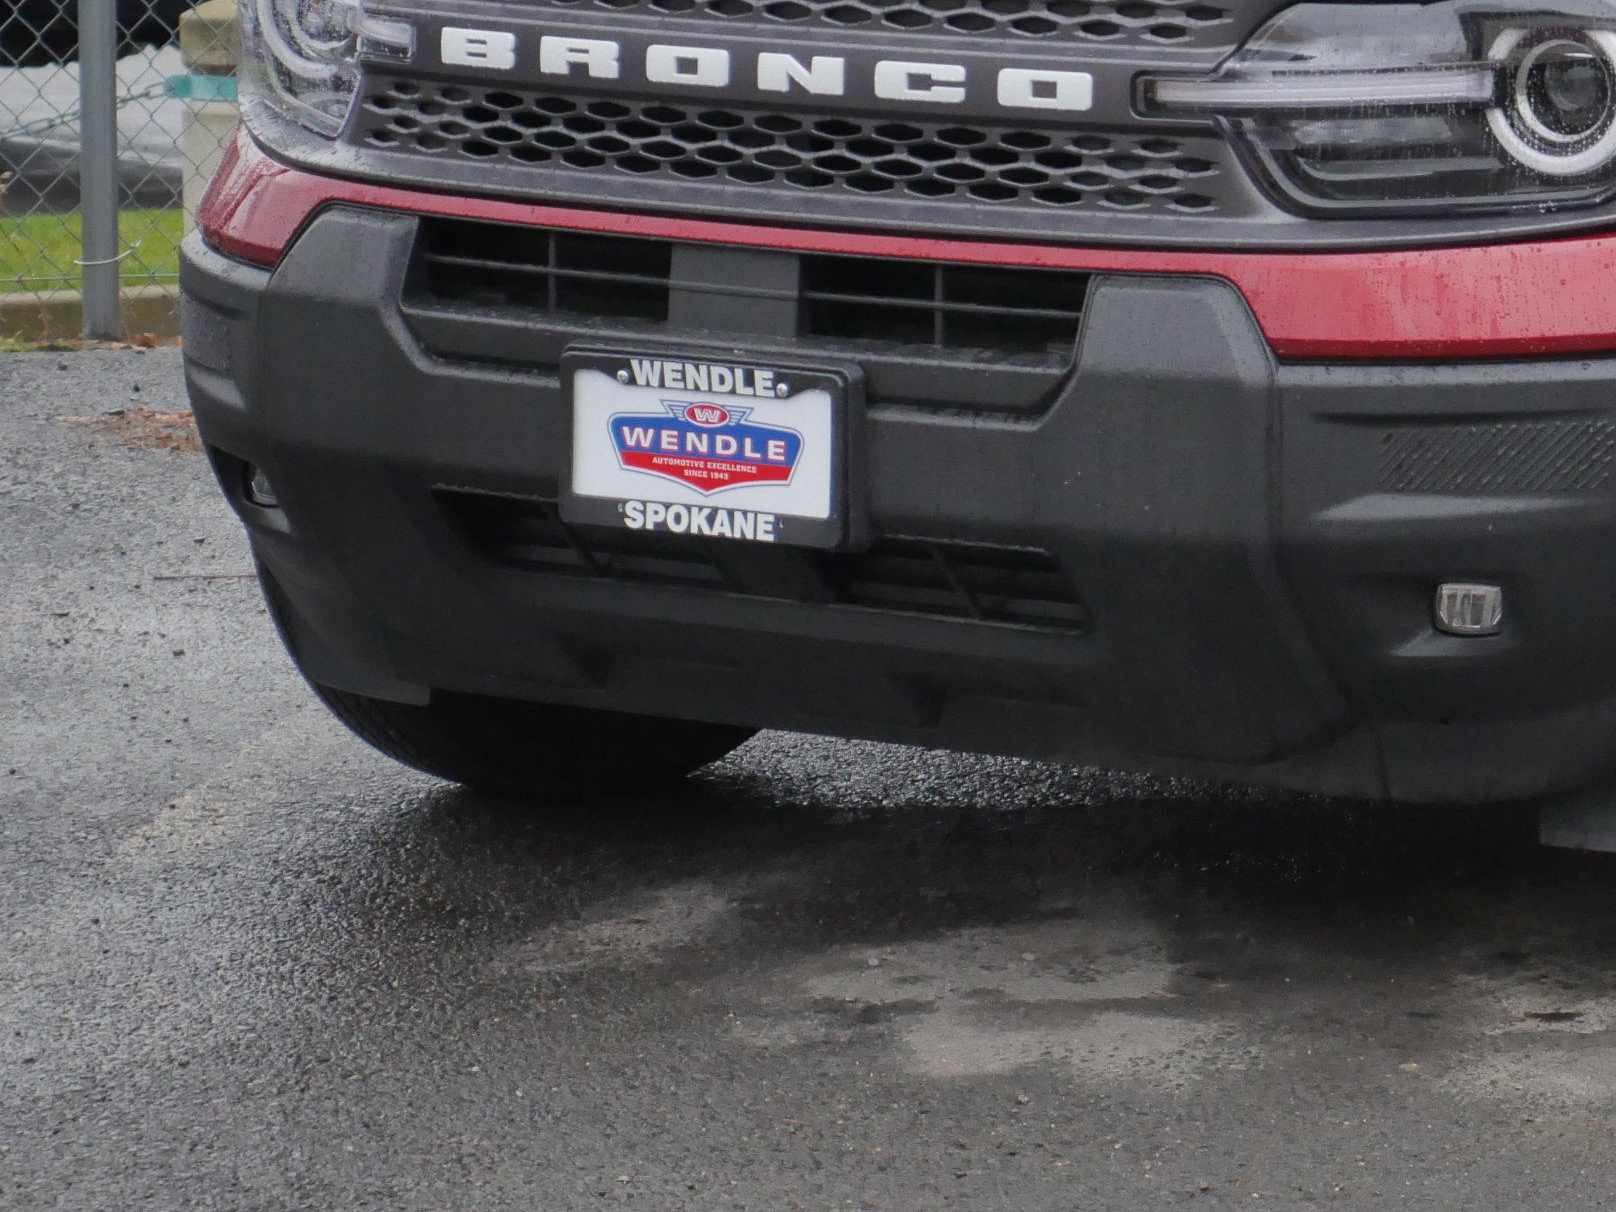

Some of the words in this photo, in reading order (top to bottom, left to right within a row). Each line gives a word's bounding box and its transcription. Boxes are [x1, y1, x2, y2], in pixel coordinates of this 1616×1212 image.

[440, 26, 1094, 112] BRONCO
[630, 359, 776, 397] WENDLE
[622, 426, 785, 461] WENDLE
[652, 457, 705, 468] AUTOMOTIVE
[707, 462, 757, 473] EXCELLENCE
[683, 469, 709, 478] SINCE
[623, 499, 776, 543] SPOKANE
